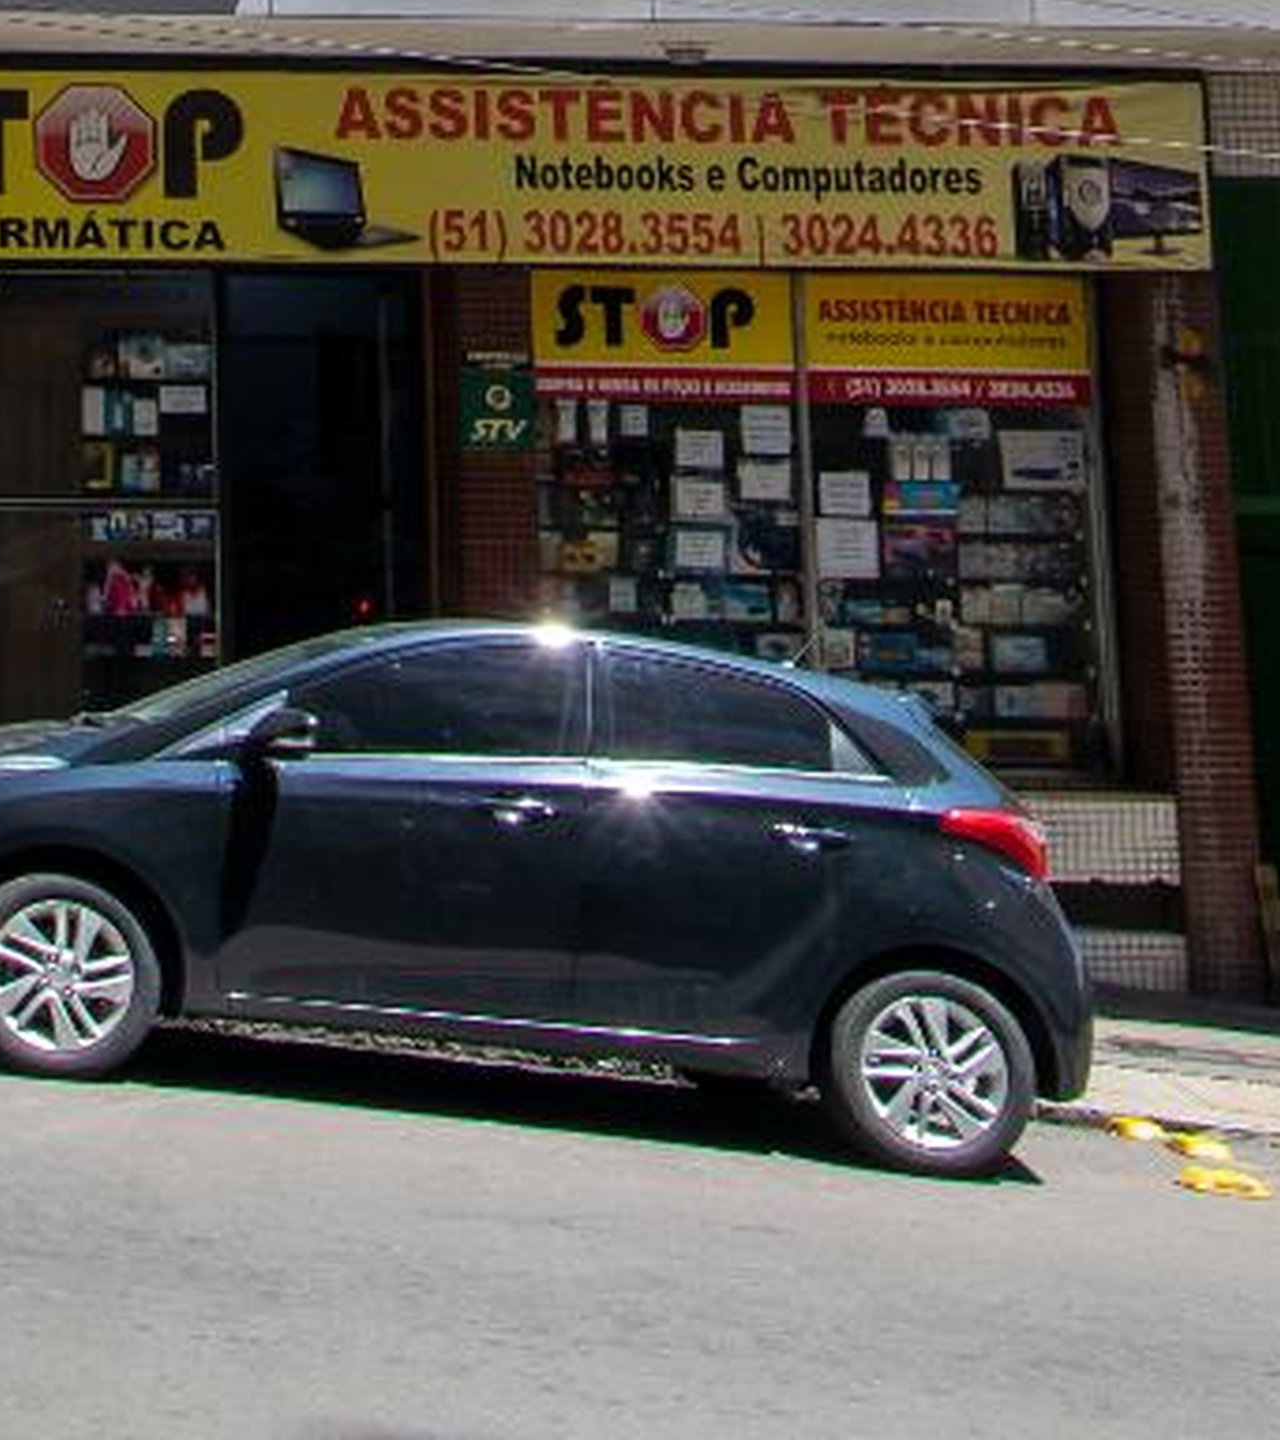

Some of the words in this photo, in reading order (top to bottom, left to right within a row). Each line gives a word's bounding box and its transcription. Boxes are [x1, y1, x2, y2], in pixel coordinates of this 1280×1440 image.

[335, 80, 796, 145] ASSISTÊNCIA
[821, 82, 1121, 147] TÉCNICA
[514, 155, 694, 193] Notebooks
[706, 163, 726, 191] e
[736, 156, 983, 202] Computadores
[428, 208, 508, 261] (51)
[523, 209, 741, 256] 3028.3554
[781, 213, 999, 259] 3024.4336
